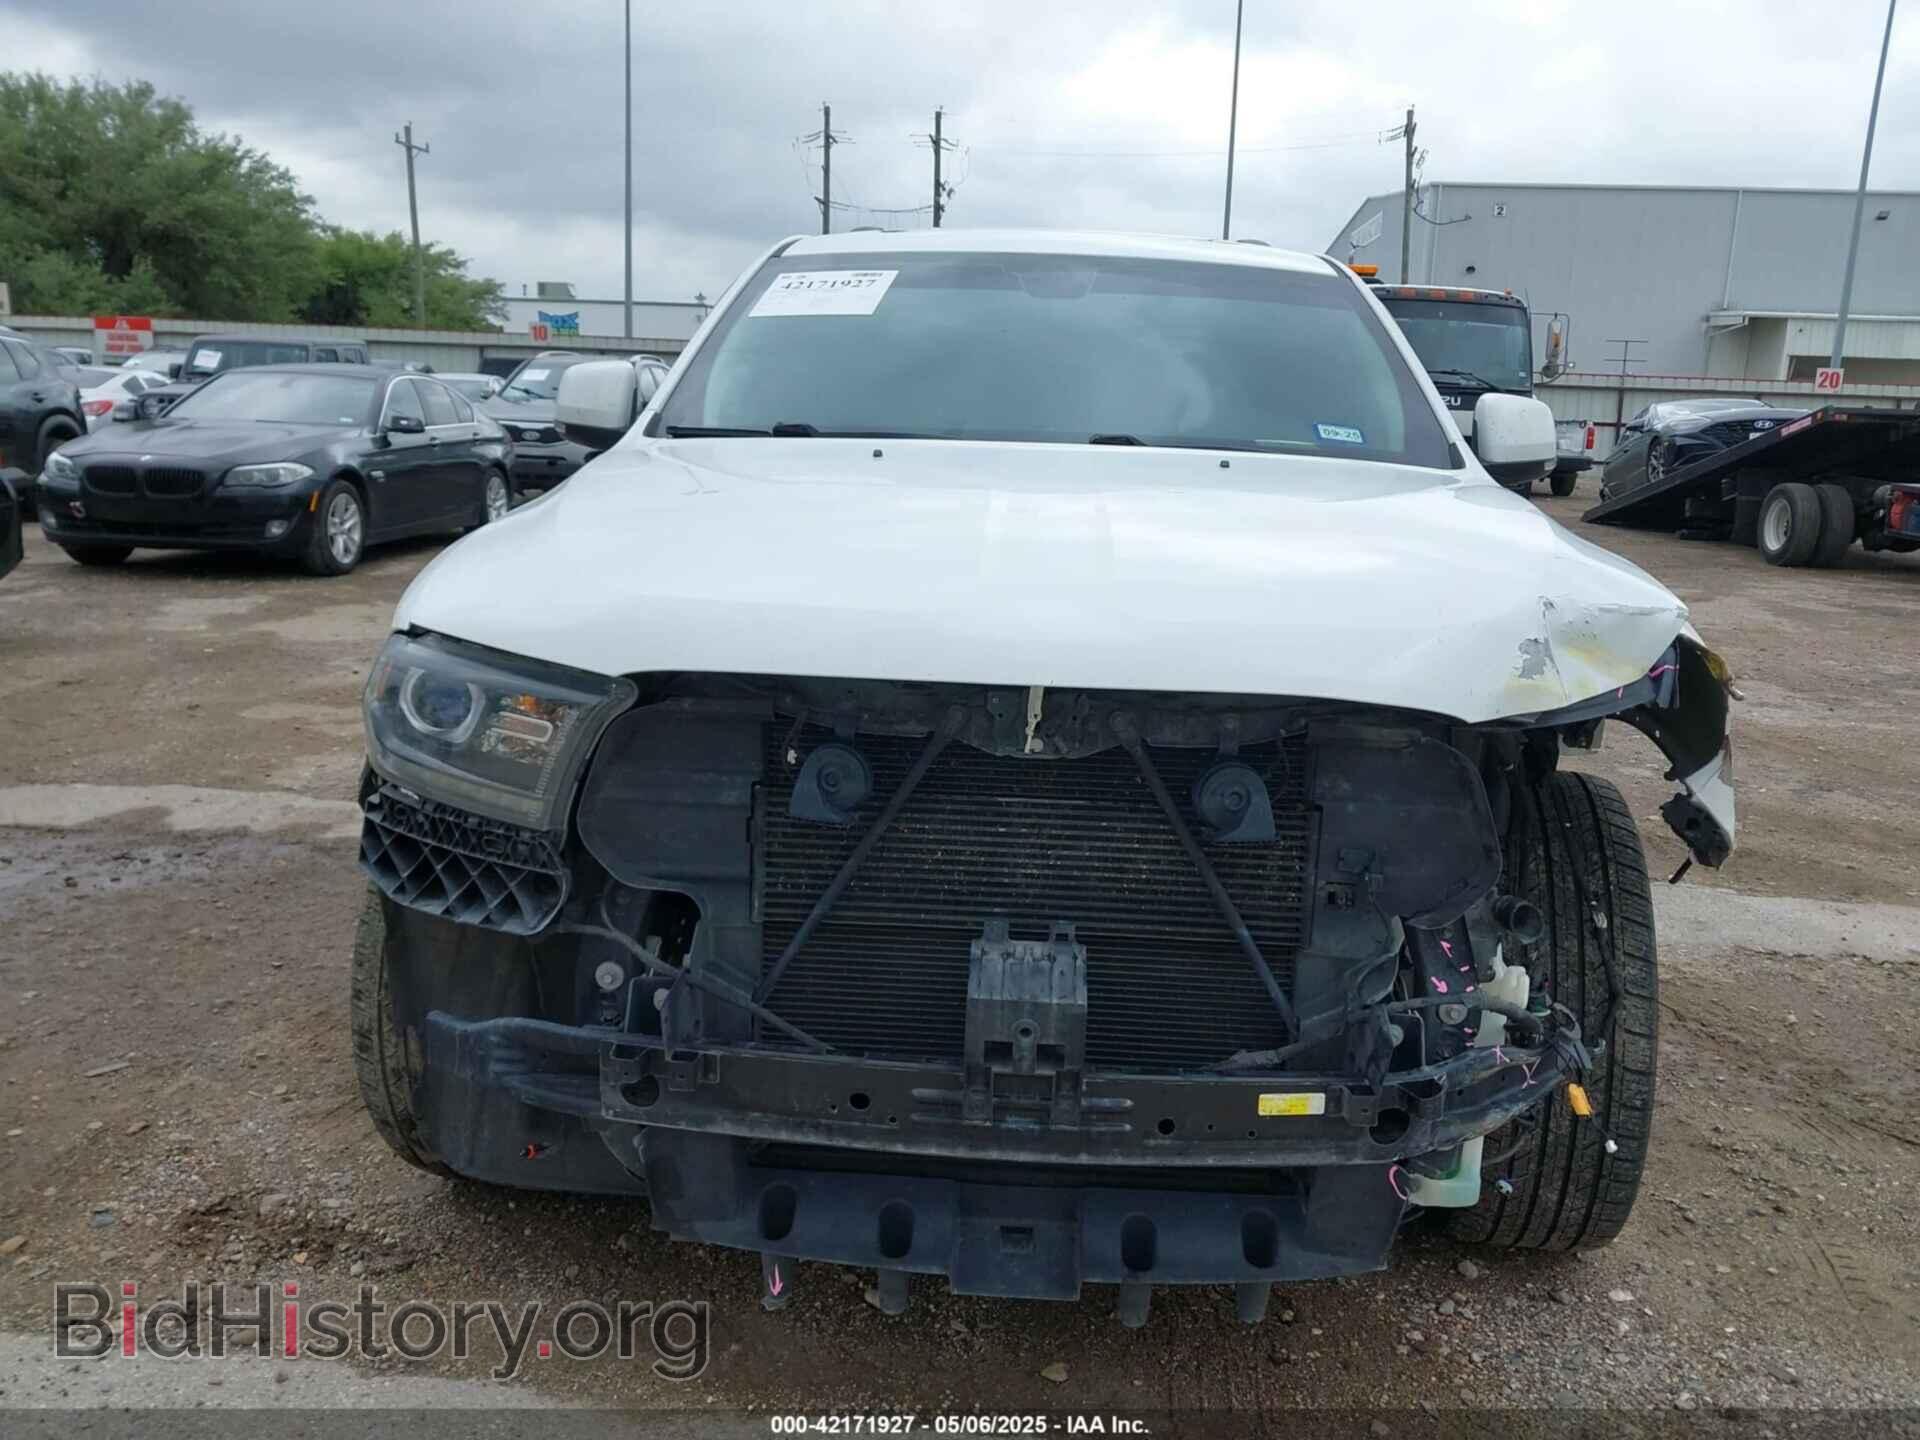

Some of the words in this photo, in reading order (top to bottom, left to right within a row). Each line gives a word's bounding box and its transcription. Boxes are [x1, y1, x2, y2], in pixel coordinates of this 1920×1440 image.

[1496, 206, 1505, 216] 2
[782, 279, 878, 290] 42171927
[530, 324, 548, 341] 10
[1817, 371, 1841, 389] 20
